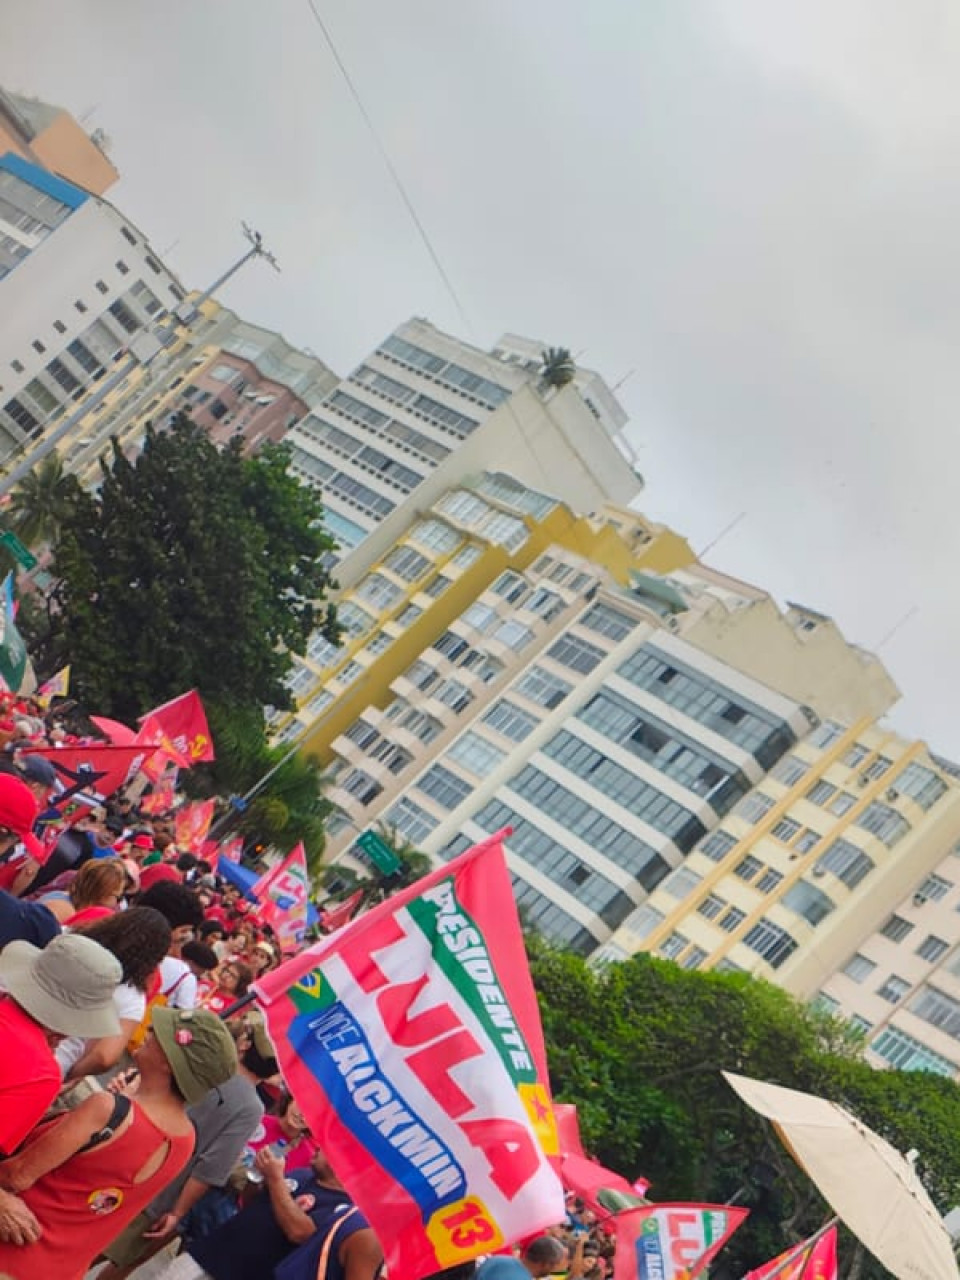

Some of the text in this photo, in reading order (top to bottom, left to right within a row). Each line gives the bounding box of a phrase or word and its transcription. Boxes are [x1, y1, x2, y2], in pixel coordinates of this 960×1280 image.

[329, 1043, 464, 1199] ALCKMIN
[334, 911, 543, 1203] LULA
[439, 1208, 496, 1259] 13
